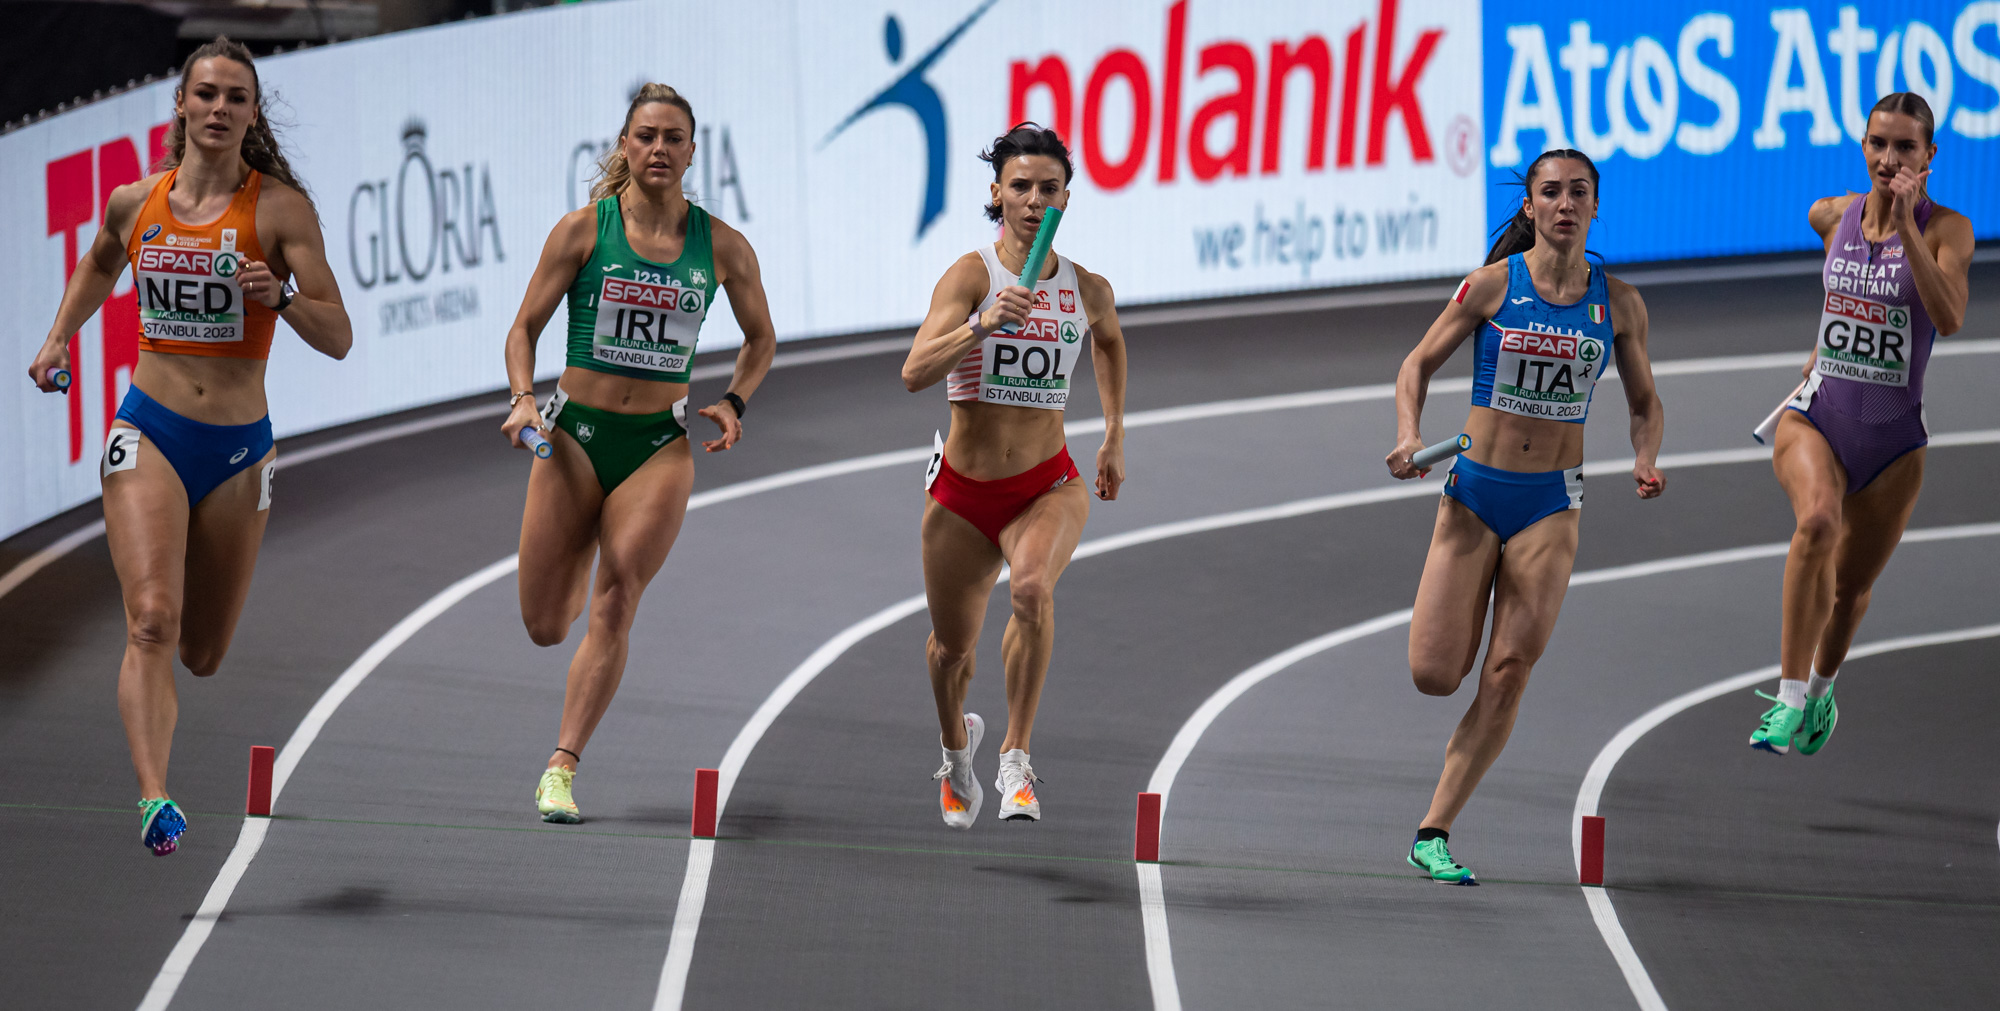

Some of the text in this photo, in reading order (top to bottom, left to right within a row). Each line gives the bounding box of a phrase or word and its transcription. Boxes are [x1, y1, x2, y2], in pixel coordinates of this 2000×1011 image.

[348, 148, 506, 290] GLORIA
[1194, 190, 1439, 281] we help to win
[142, 251, 210, 272] SPAR
[1831, 257, 1902, 279] GREAT
[633, 269, 682, 287] 123ie
[1828, 275, 1900, 297] BRITAIN
[145, 277, 233, 315] NED
[605, 282, 676, 307] SPAR
[162, 312, 182, 320] RUN
[1827, 295, 1886, 322] SPAR
[144, 322, 235, 338] ISTANBUL 2023
[614, 308, 679, 346] IRL
[1527, 321, 1584, 337] ITALIA
[620, 339, 641, 348] RUN
[1504, 333, 1575, 357] SPAR
[1823, 320, 1905, 363] GBR
[600, 348, 684, 369] ISTANBUL 2023
[992, 343, 1065, 380] POL
[1837, 352, 1856, 361] RUN
[1007, 378, 1028, 386] RUN
[1516, 358, 1575, 394] ITA
[1820, 360, 1901, 383] ISTANBUL 2023
[986, 388, 1067, 404] ISTANBUL 2023
[1519, 388, 1539, 399] RUN
[1497, 396, 1582, 416] ISTANBUL 2023
[108, 434, 126, 466] 6
